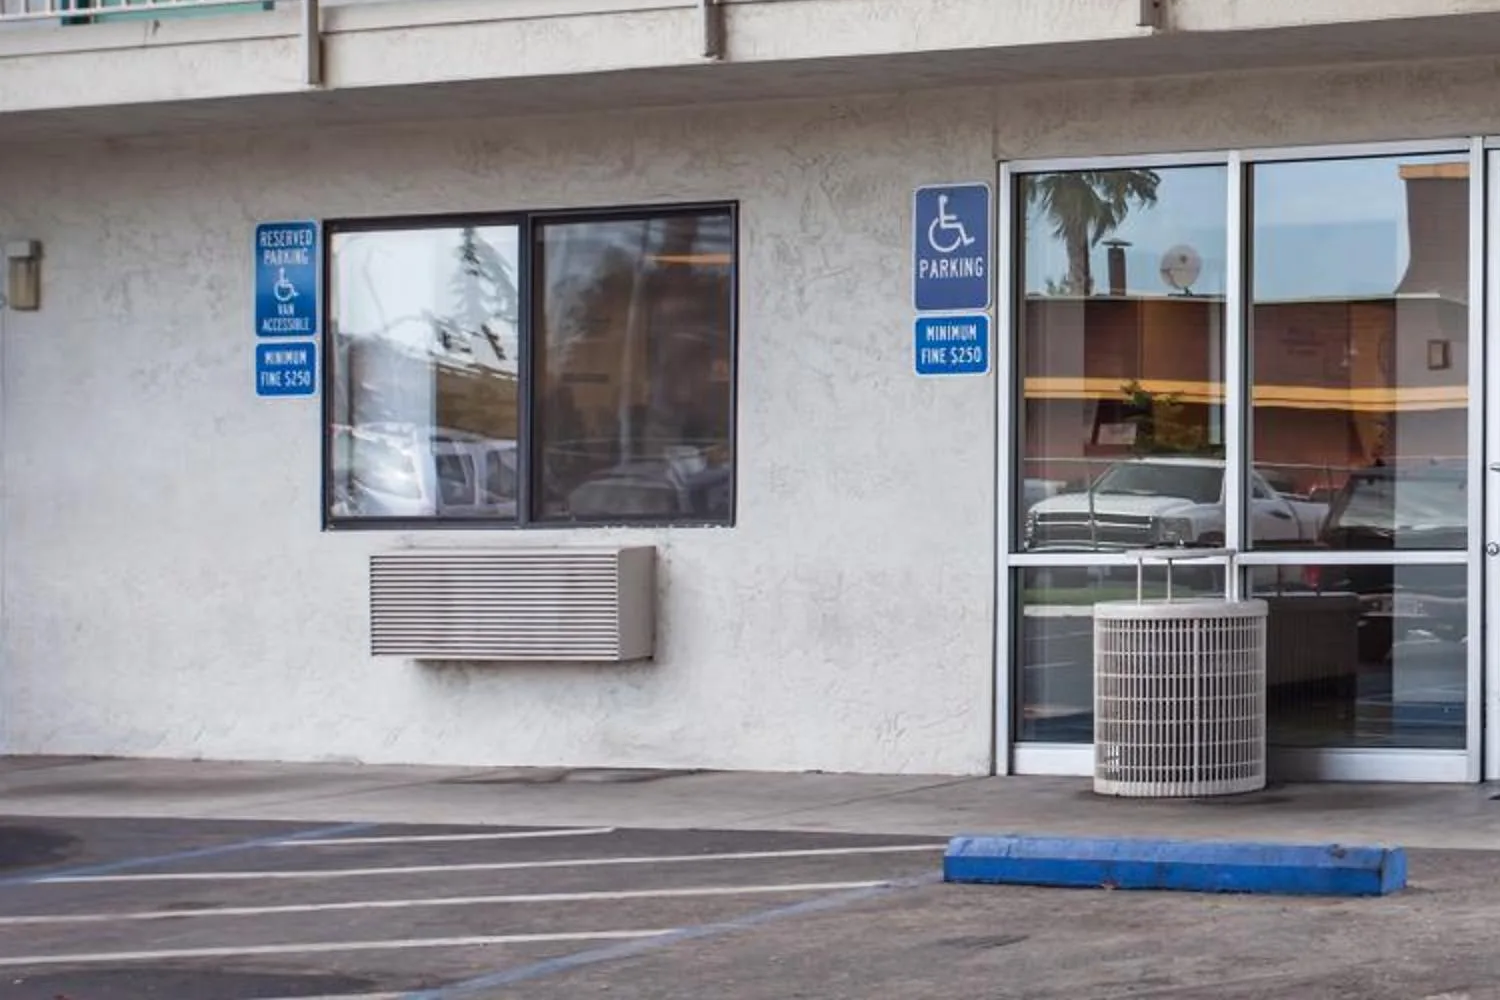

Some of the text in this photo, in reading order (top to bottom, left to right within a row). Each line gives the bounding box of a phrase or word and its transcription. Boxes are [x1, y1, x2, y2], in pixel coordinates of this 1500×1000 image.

[259, 229, 314, 247] RESERVED
[263, 248, 310, 266] PARKING
[918, 256, 985, 279] PARKING
[277, 302, 296, 316] VAN
[261, 316, 311, 332] ACCESSIBLE
[925, 323, 978, 342] MINIMUM
[263, 350, 308, 366] MINIMUM
[920, 347, 947, 365] FINE
[260, 371, 283, 388] FINE
